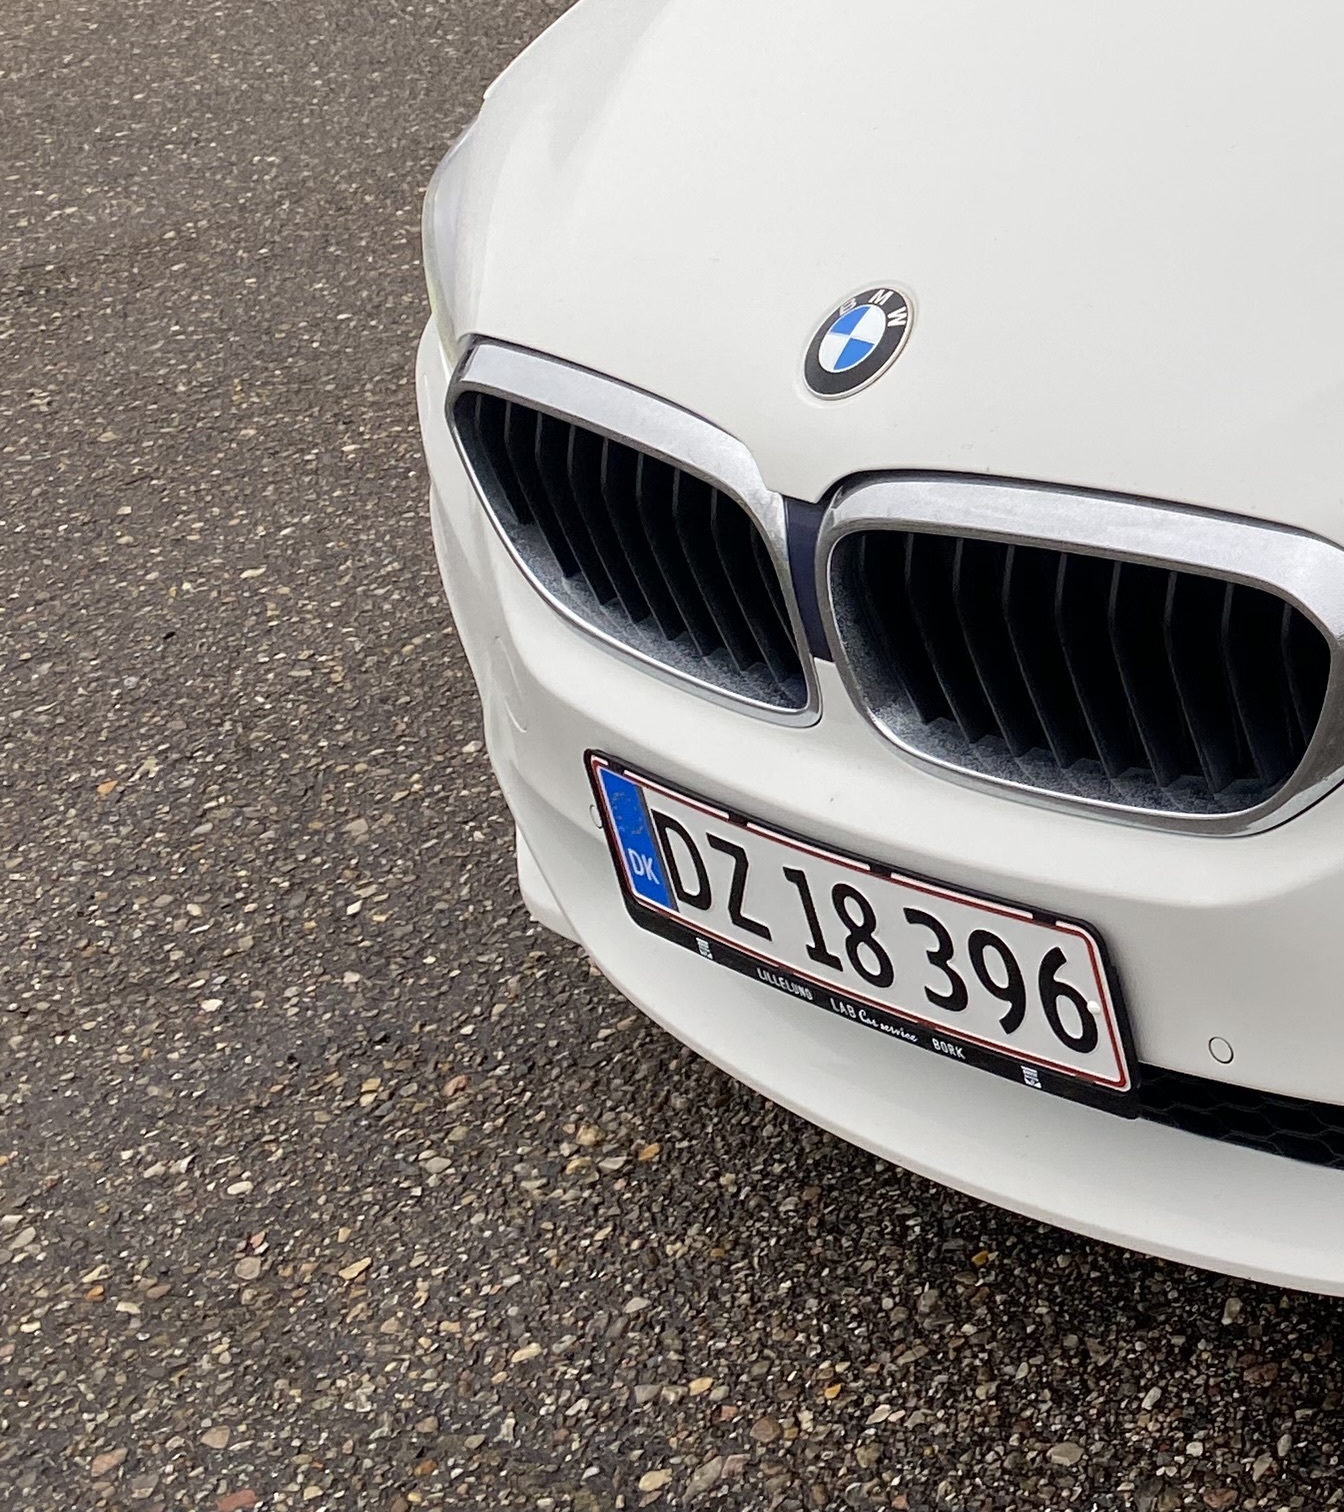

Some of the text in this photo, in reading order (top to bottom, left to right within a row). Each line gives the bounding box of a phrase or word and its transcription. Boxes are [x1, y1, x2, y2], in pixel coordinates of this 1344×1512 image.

[838, 288, 909, 328] BMW
[625, 848, 662, 886] DK
[651, 807, 1100, 1055] DZ 18 396
[756, 967, 814, 1002] LILLELUND
[829, 997, 857, 1022] LAB
[931, 1037, 967, 1061] BORK
